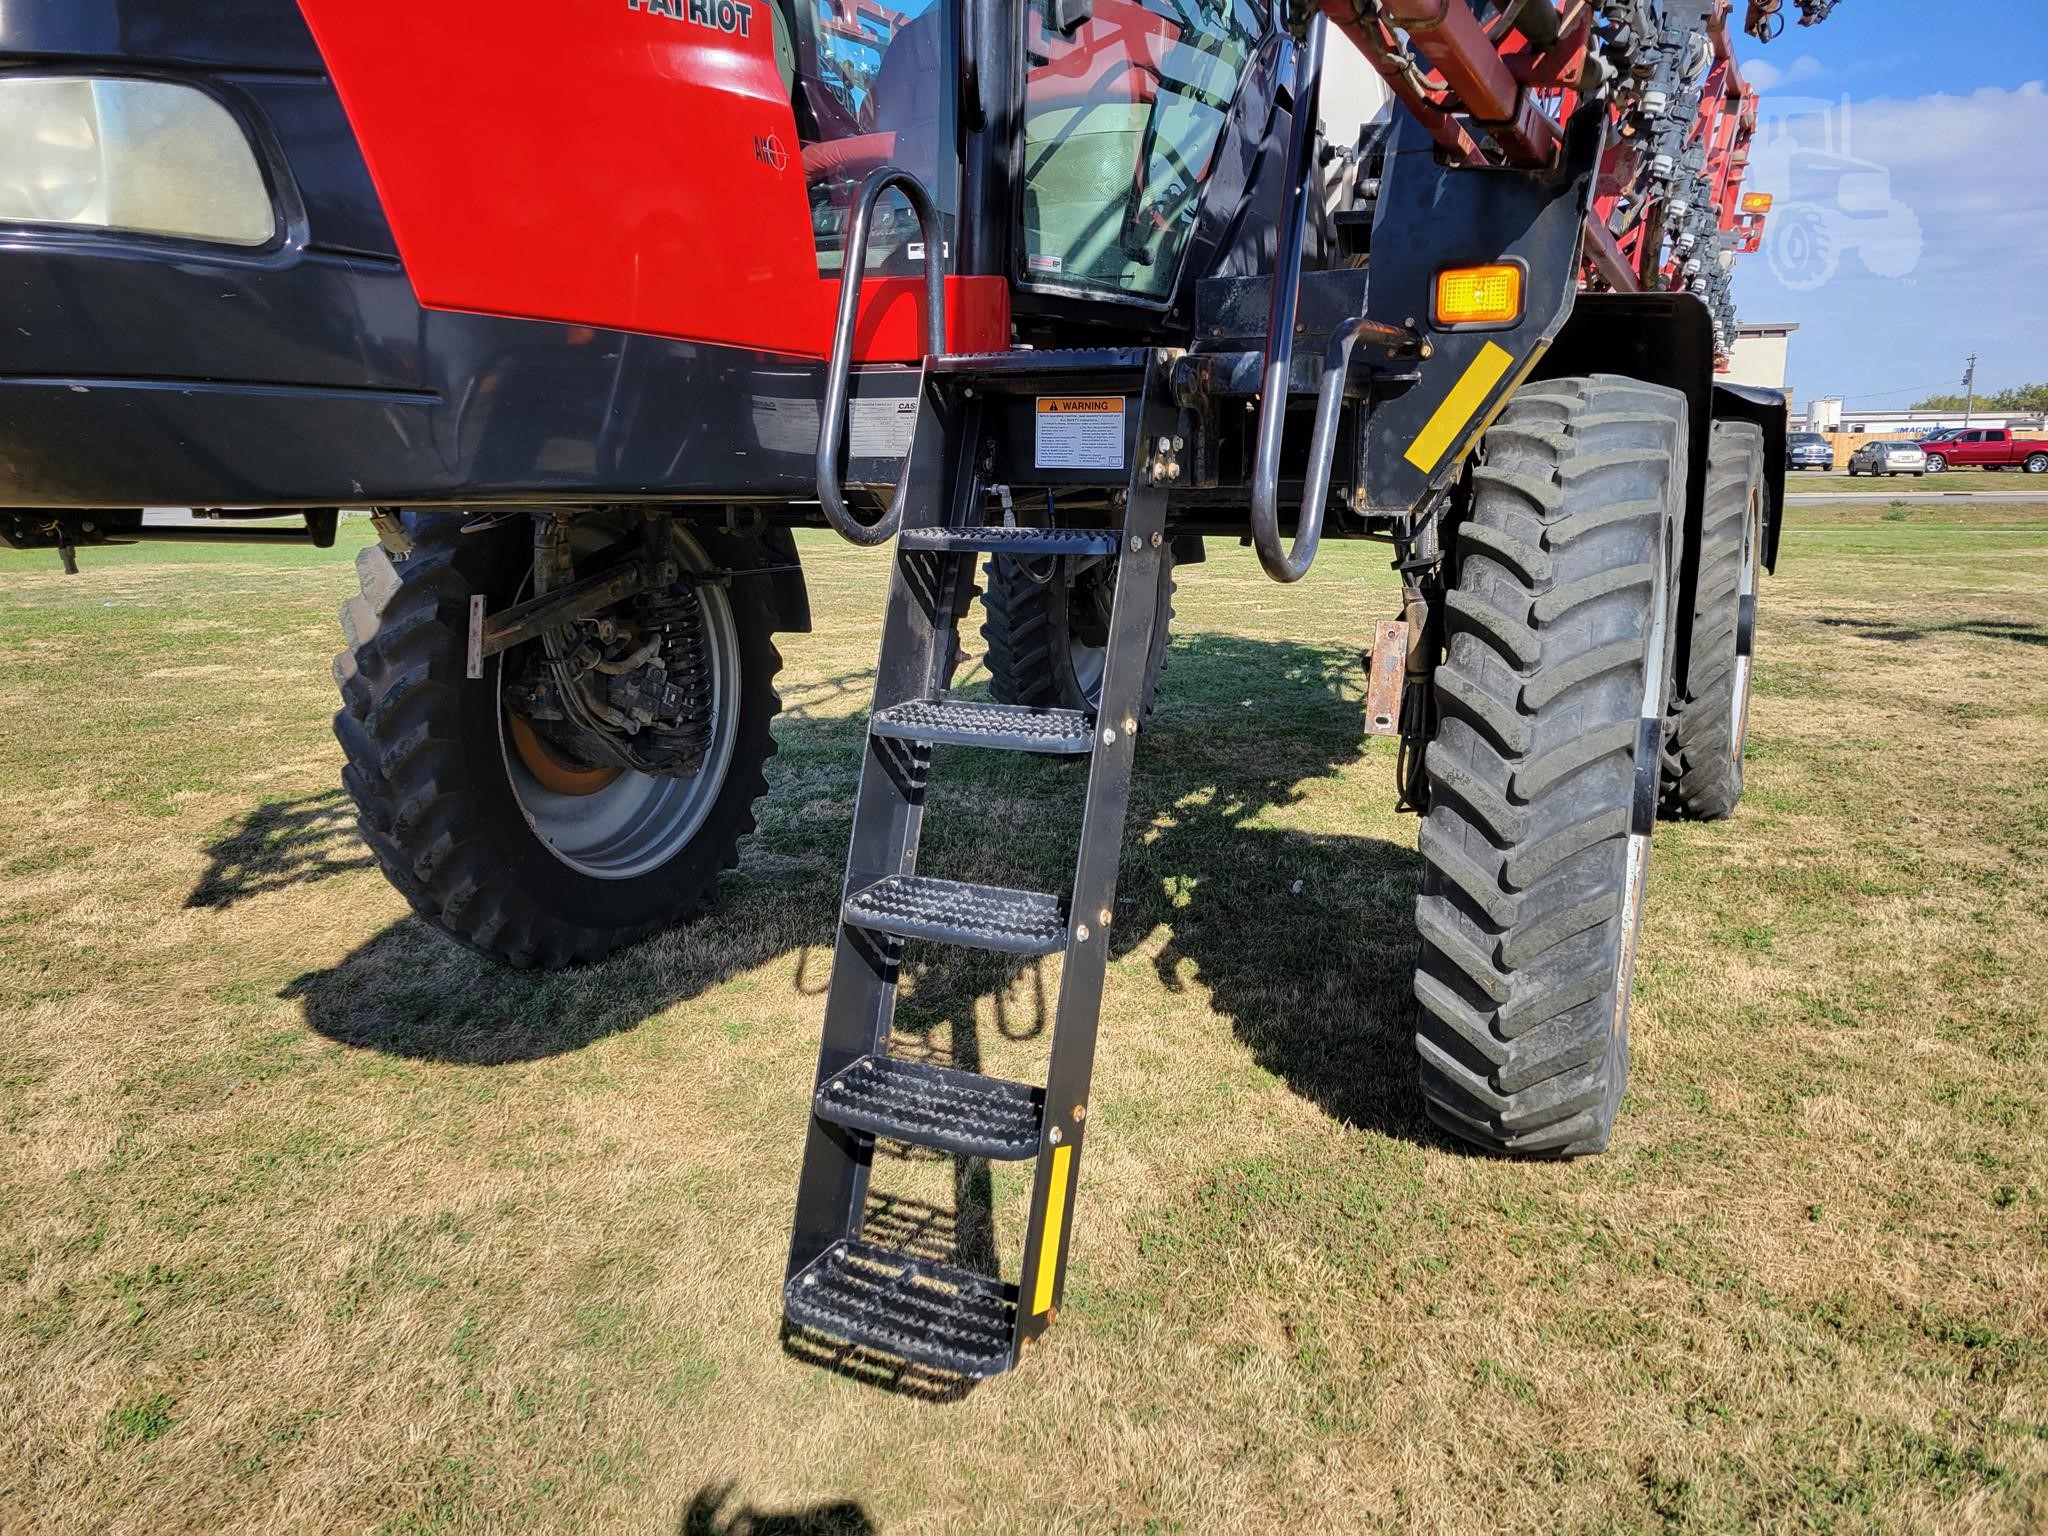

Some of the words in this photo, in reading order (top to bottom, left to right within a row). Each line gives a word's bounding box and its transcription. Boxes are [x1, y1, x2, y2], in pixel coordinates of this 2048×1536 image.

[628, 0, 752, 38] ATRIOT
[898, 402, 917, 410] CAS
[1062, 401, 1109, 411] WARNING
